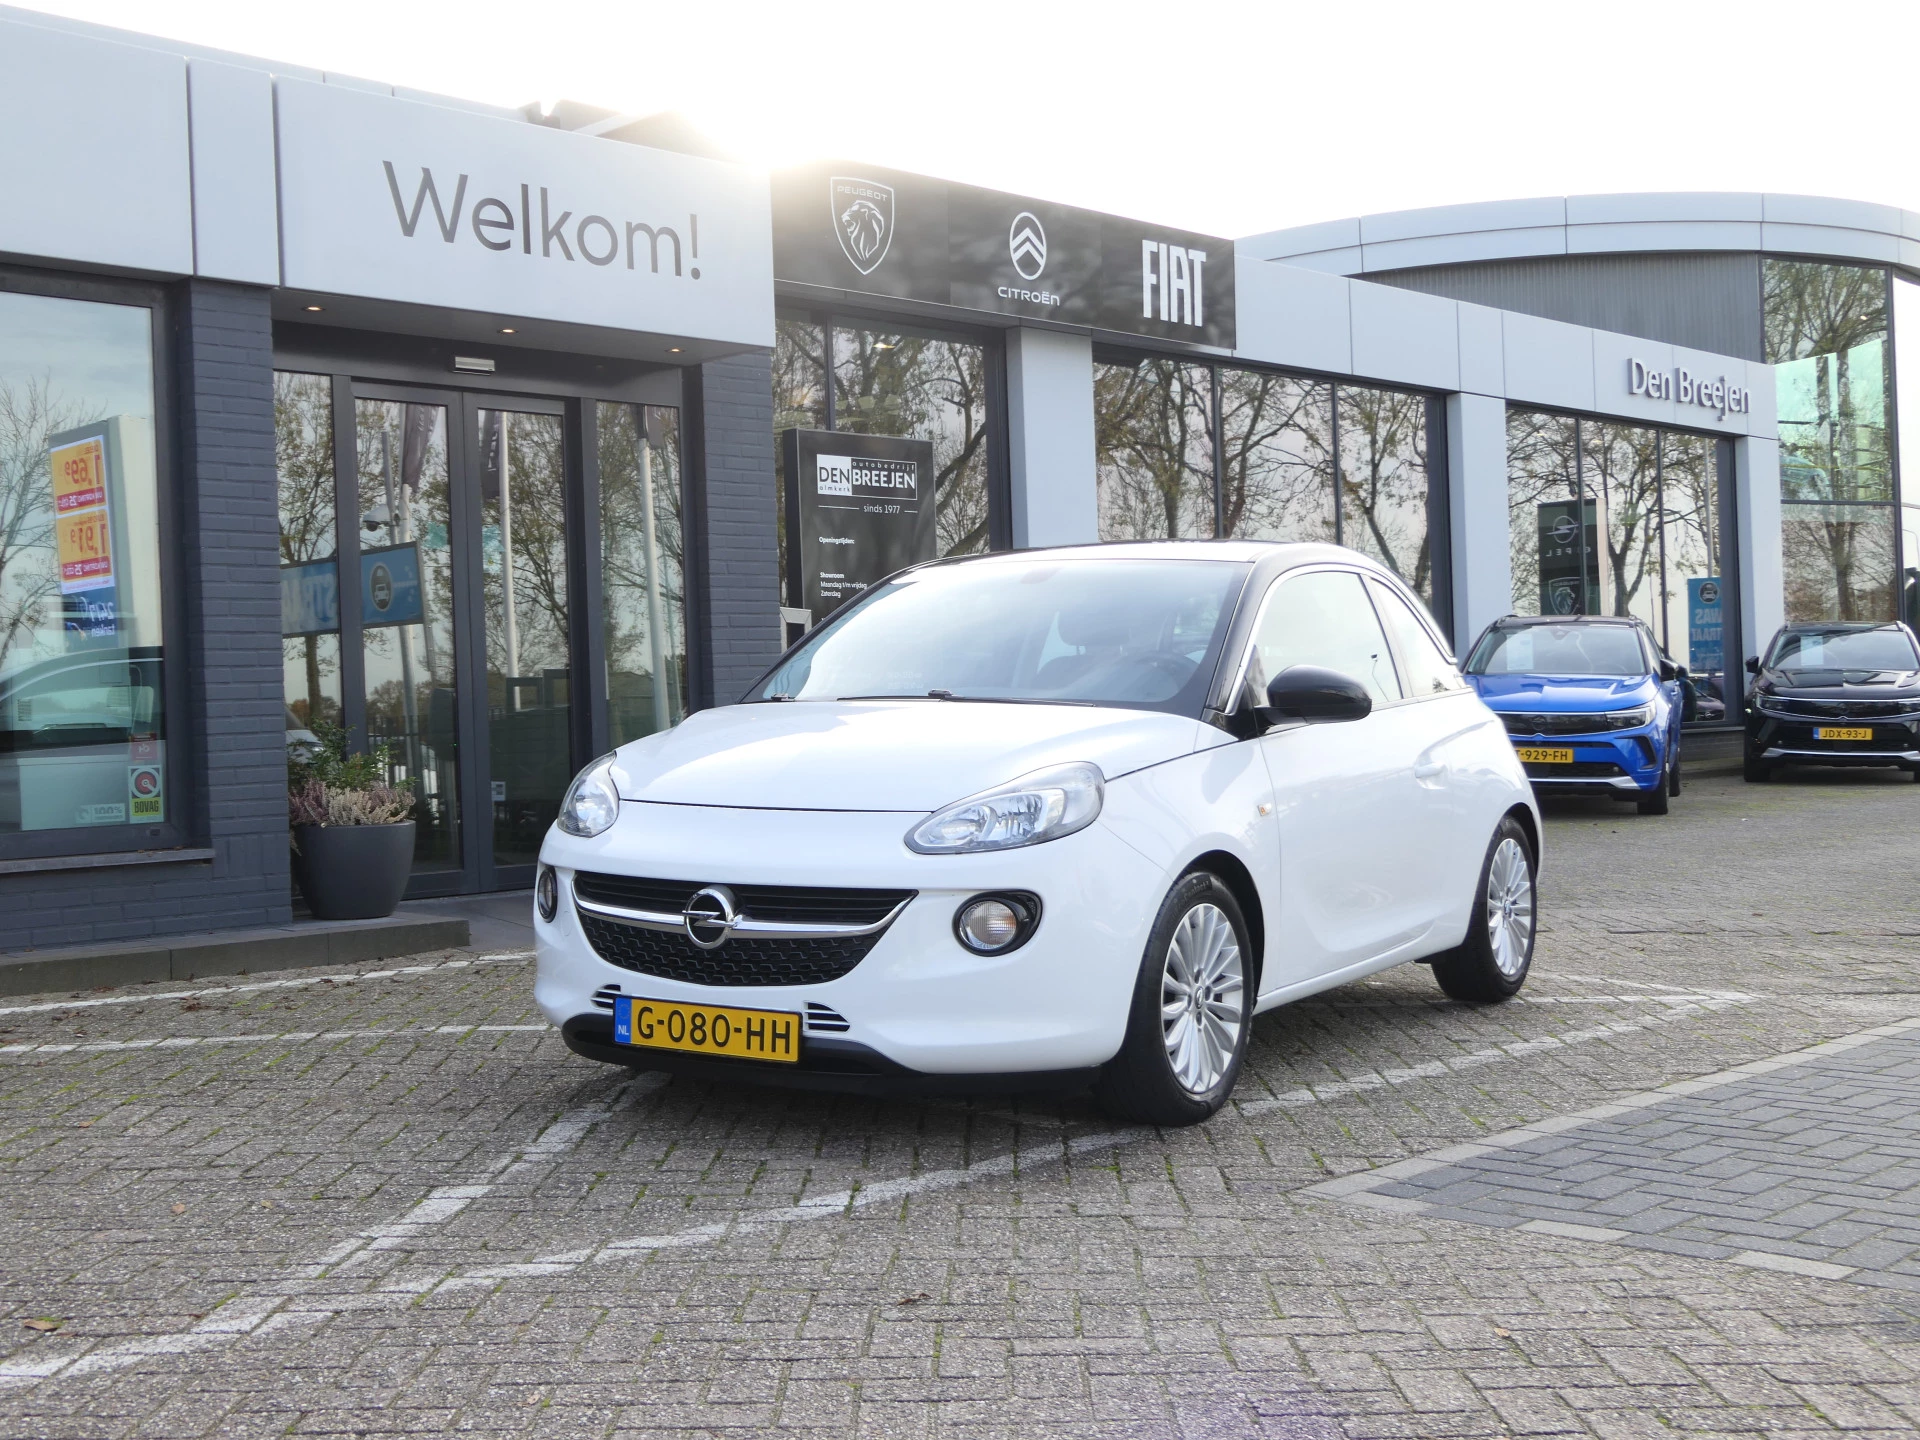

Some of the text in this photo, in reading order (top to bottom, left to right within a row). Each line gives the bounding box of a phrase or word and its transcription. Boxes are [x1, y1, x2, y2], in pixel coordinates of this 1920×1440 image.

[837, 186, 888, 201] PEUGEOT
[382, 160, 701, 280] Welkom!
[1142, 239, 1207, 327] FIAT
[997, 286, 1060, 306] CITROËN
[1627, 358, 1751, 421] Den Breejen
[852, 461, 915, 471] autobedrijf
[819, 467, 915, 489] DEN BREEJEN
[863, 504, 900, 514] sinds 1977
[820, 581, 842, 589] Maandag
[820, 590, 841, 598] Zaterdag
[1822, 730, 1867, 739] JDX-93-J
[94, 806, 123, 815] 100%
[134, 800, 159, 813] BOVAG
[618, 1024, 630, 1036] NL
[637, 1006, 791, 1054] G-080-HH
